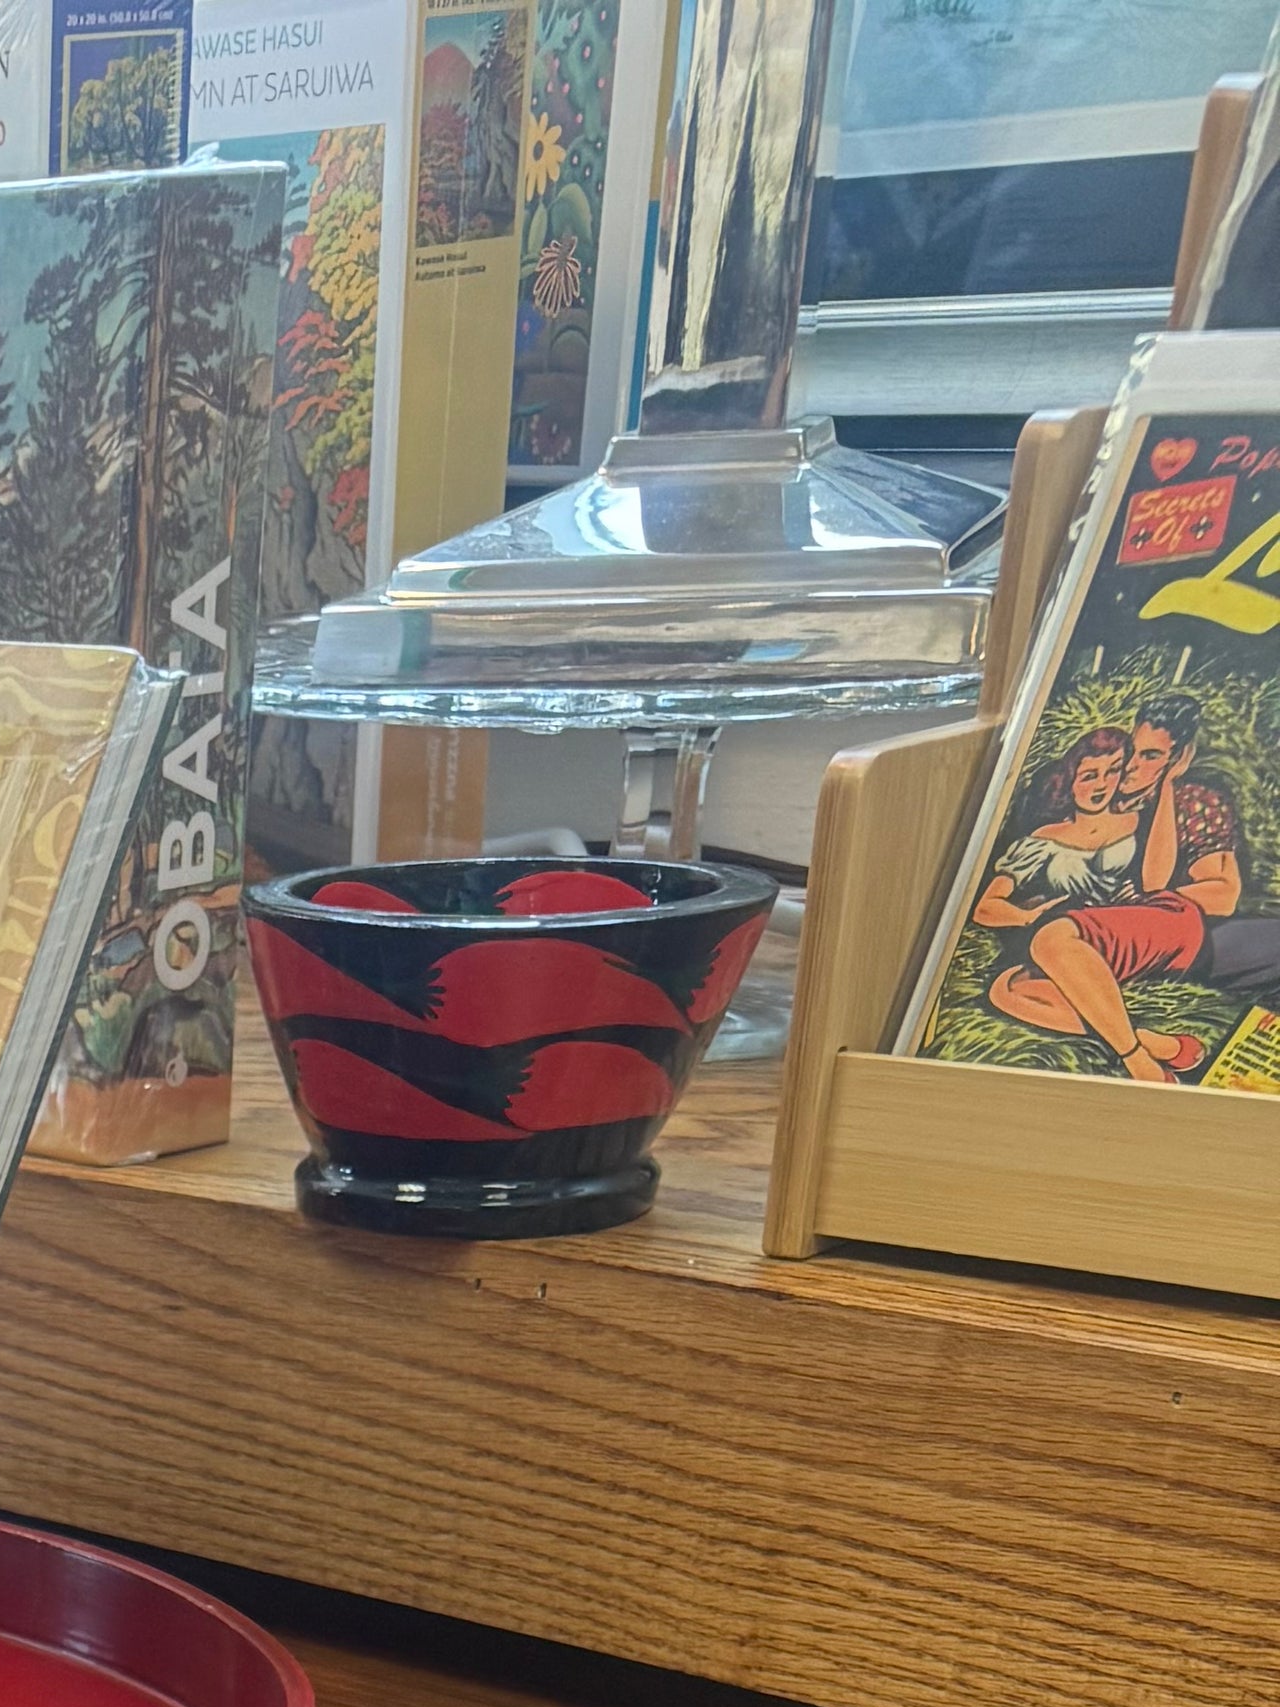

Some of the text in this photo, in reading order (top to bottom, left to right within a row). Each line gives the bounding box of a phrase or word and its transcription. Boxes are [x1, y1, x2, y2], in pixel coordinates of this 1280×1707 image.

[194, 20, 323, 60] AWASE HASUI
[231, 74, 259, 106] AT
[265, 60, 374, 102] SARUIWA
[1131, 486, 1225, 523] Secrets
[1151, 515, 1190, 553] Of
[153, 555, 232, 991] OBATA
